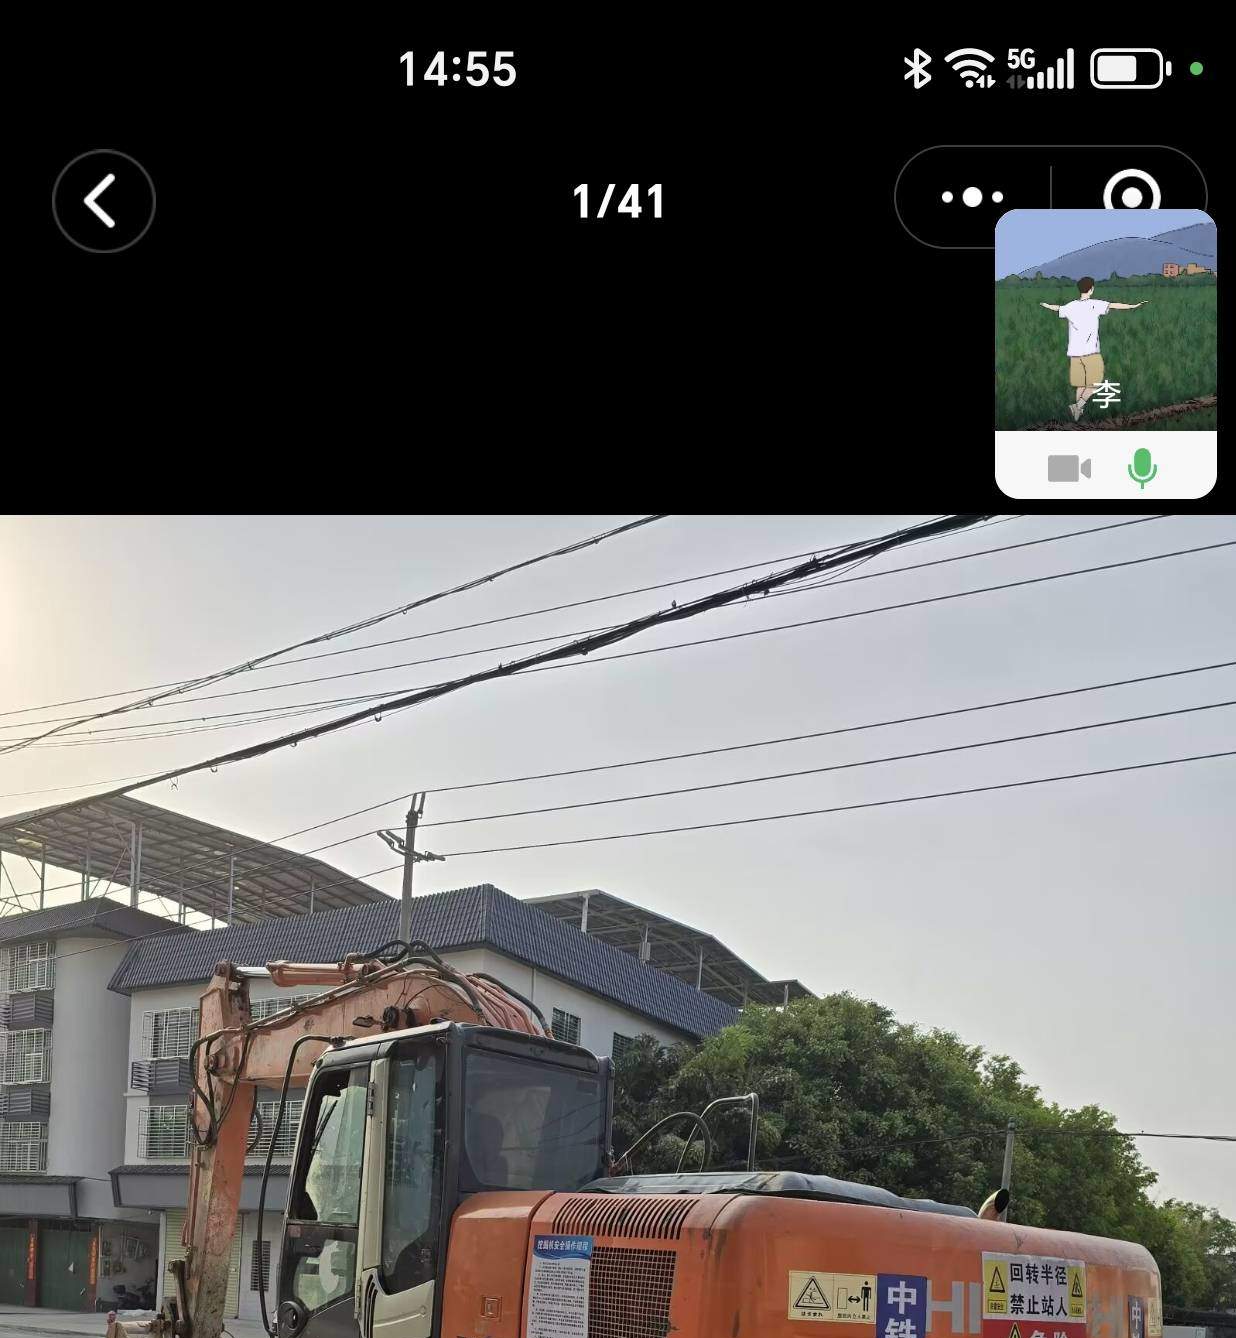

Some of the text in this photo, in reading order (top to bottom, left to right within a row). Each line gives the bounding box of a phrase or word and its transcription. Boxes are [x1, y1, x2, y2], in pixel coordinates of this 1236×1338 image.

[1010, 1263, 1067, 1285] 回转半径
[1010, 1294, 1067, 1316] 禁止站人
